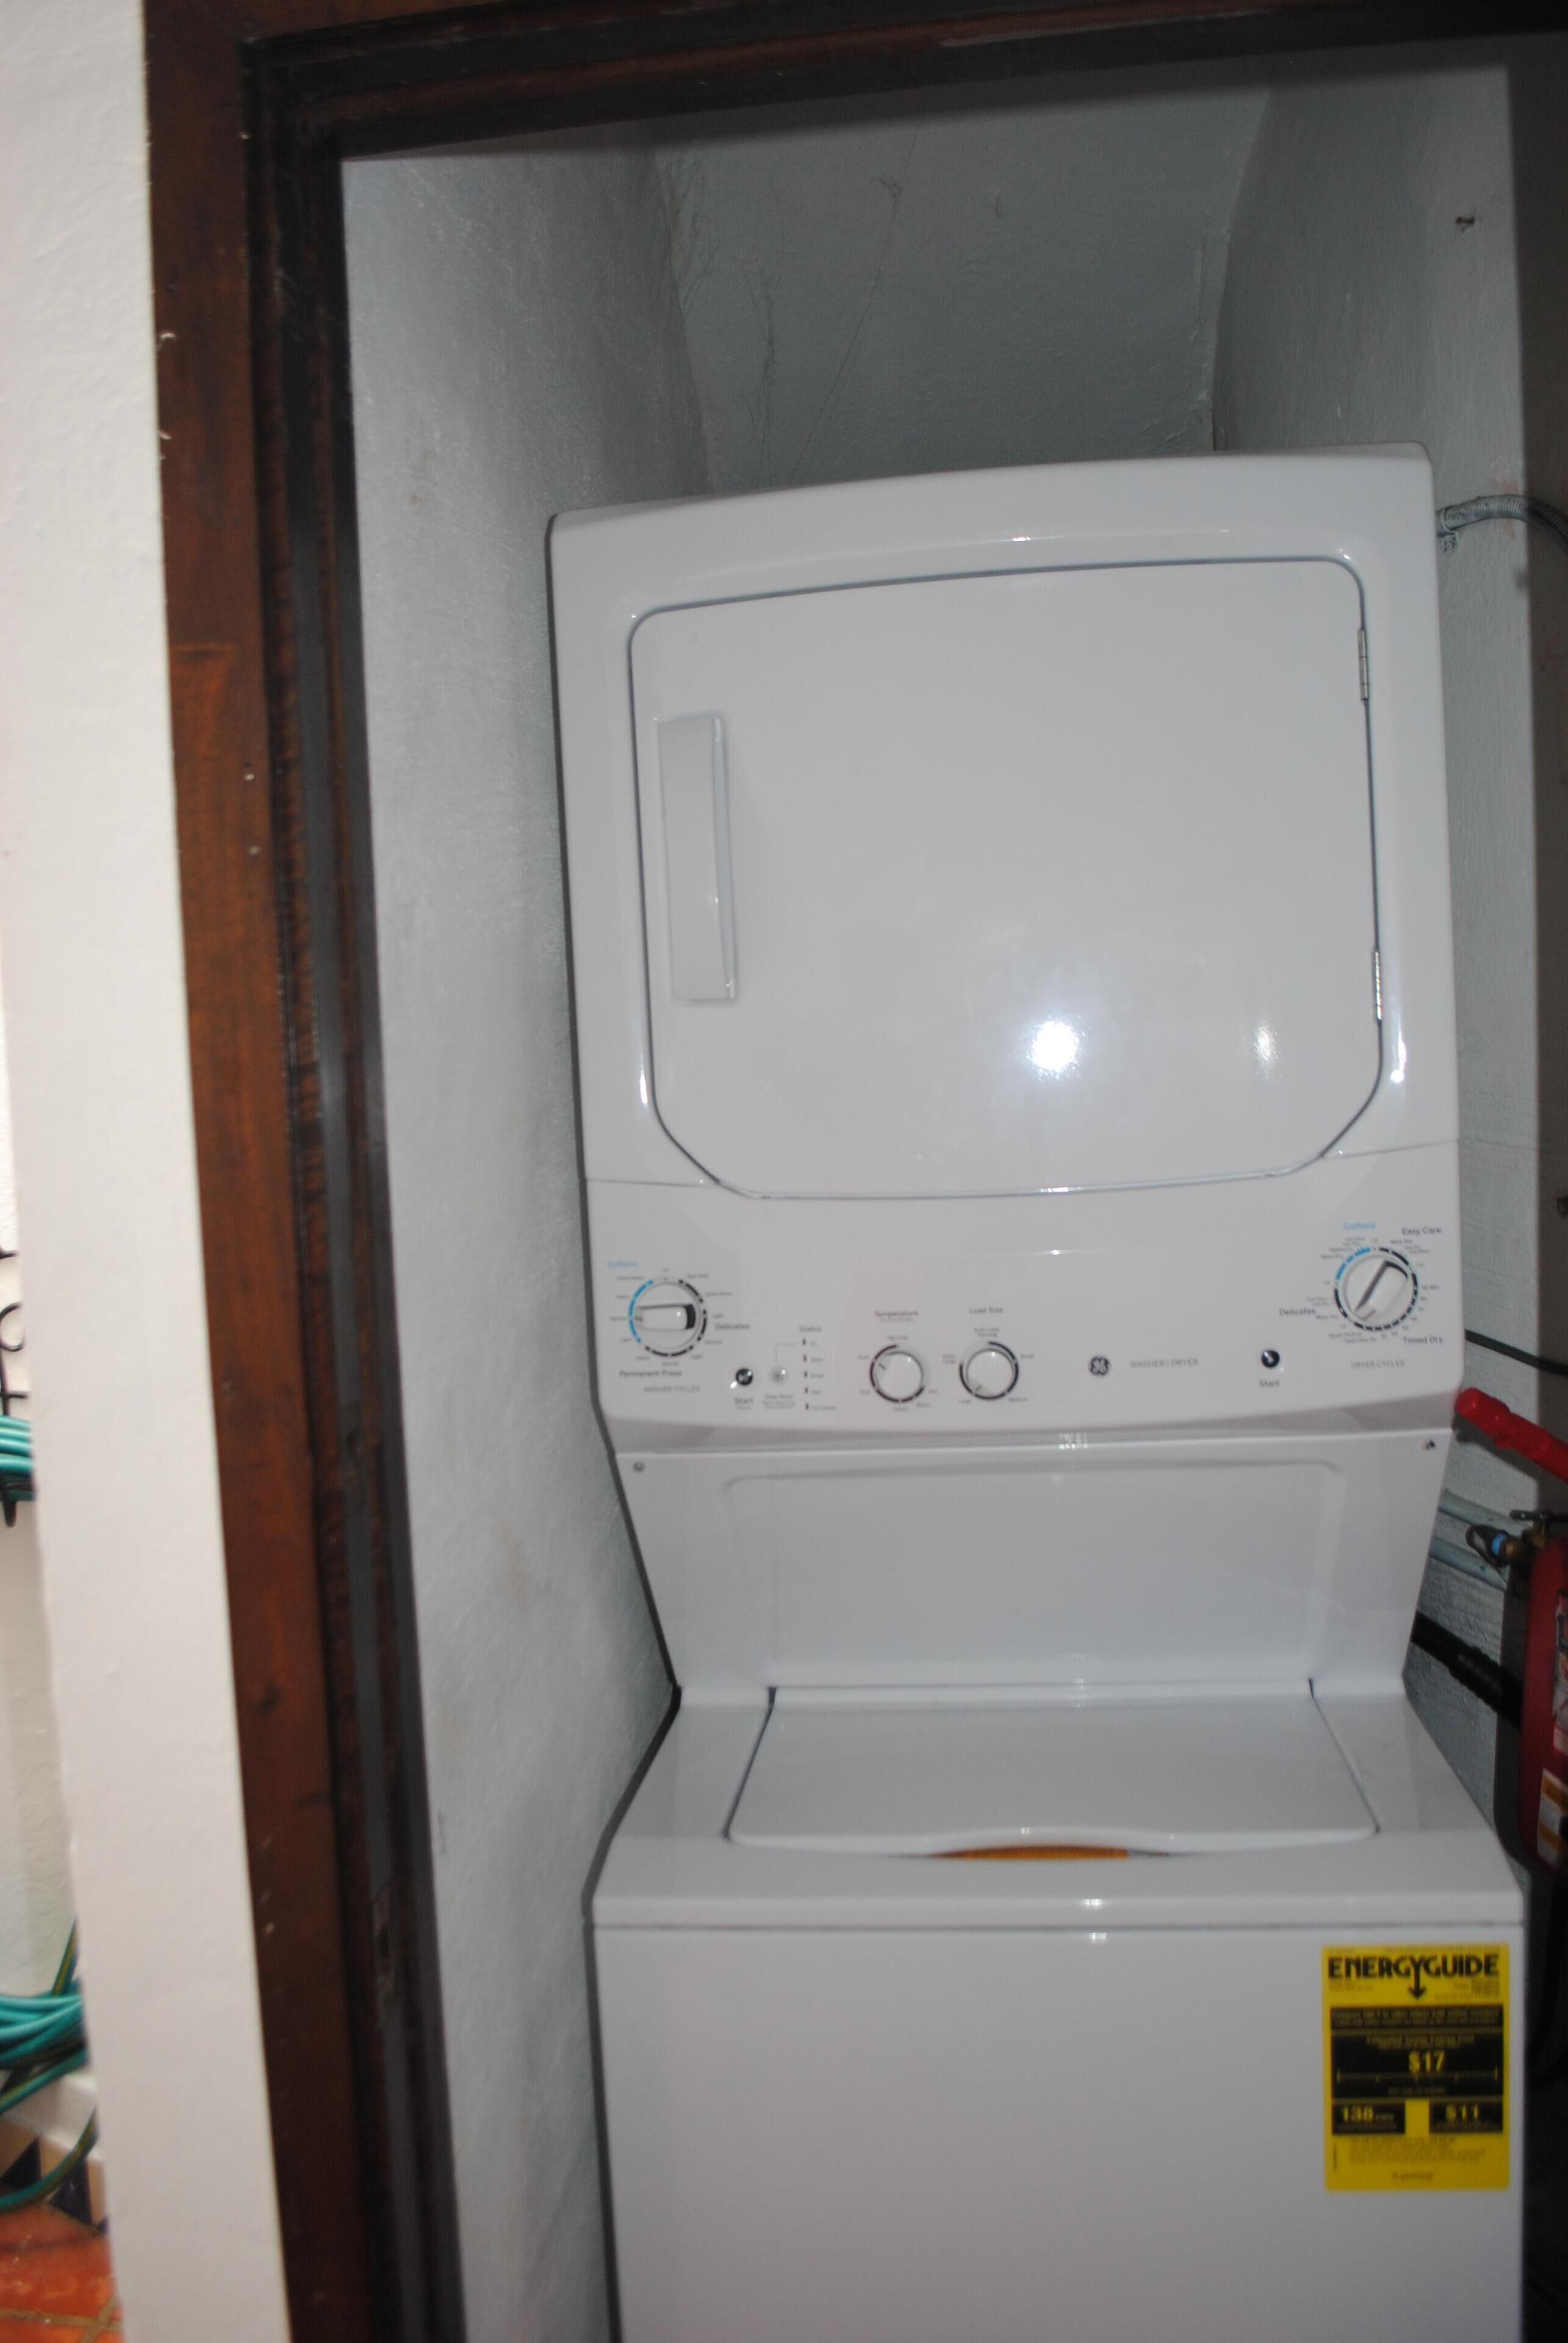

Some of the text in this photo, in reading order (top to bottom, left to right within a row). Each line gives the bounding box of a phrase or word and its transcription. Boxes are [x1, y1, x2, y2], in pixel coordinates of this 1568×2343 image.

[1402, 1226, 1441, 1236] Easy Care
[874, 1309, 918, 1318] Temperature
[1430, 1334, 1444, 1344] Dry
[1351, 1360, 1375, 1369] DRYER
[1328, 1954, 1499, 1980] ENERGYGUIDE
